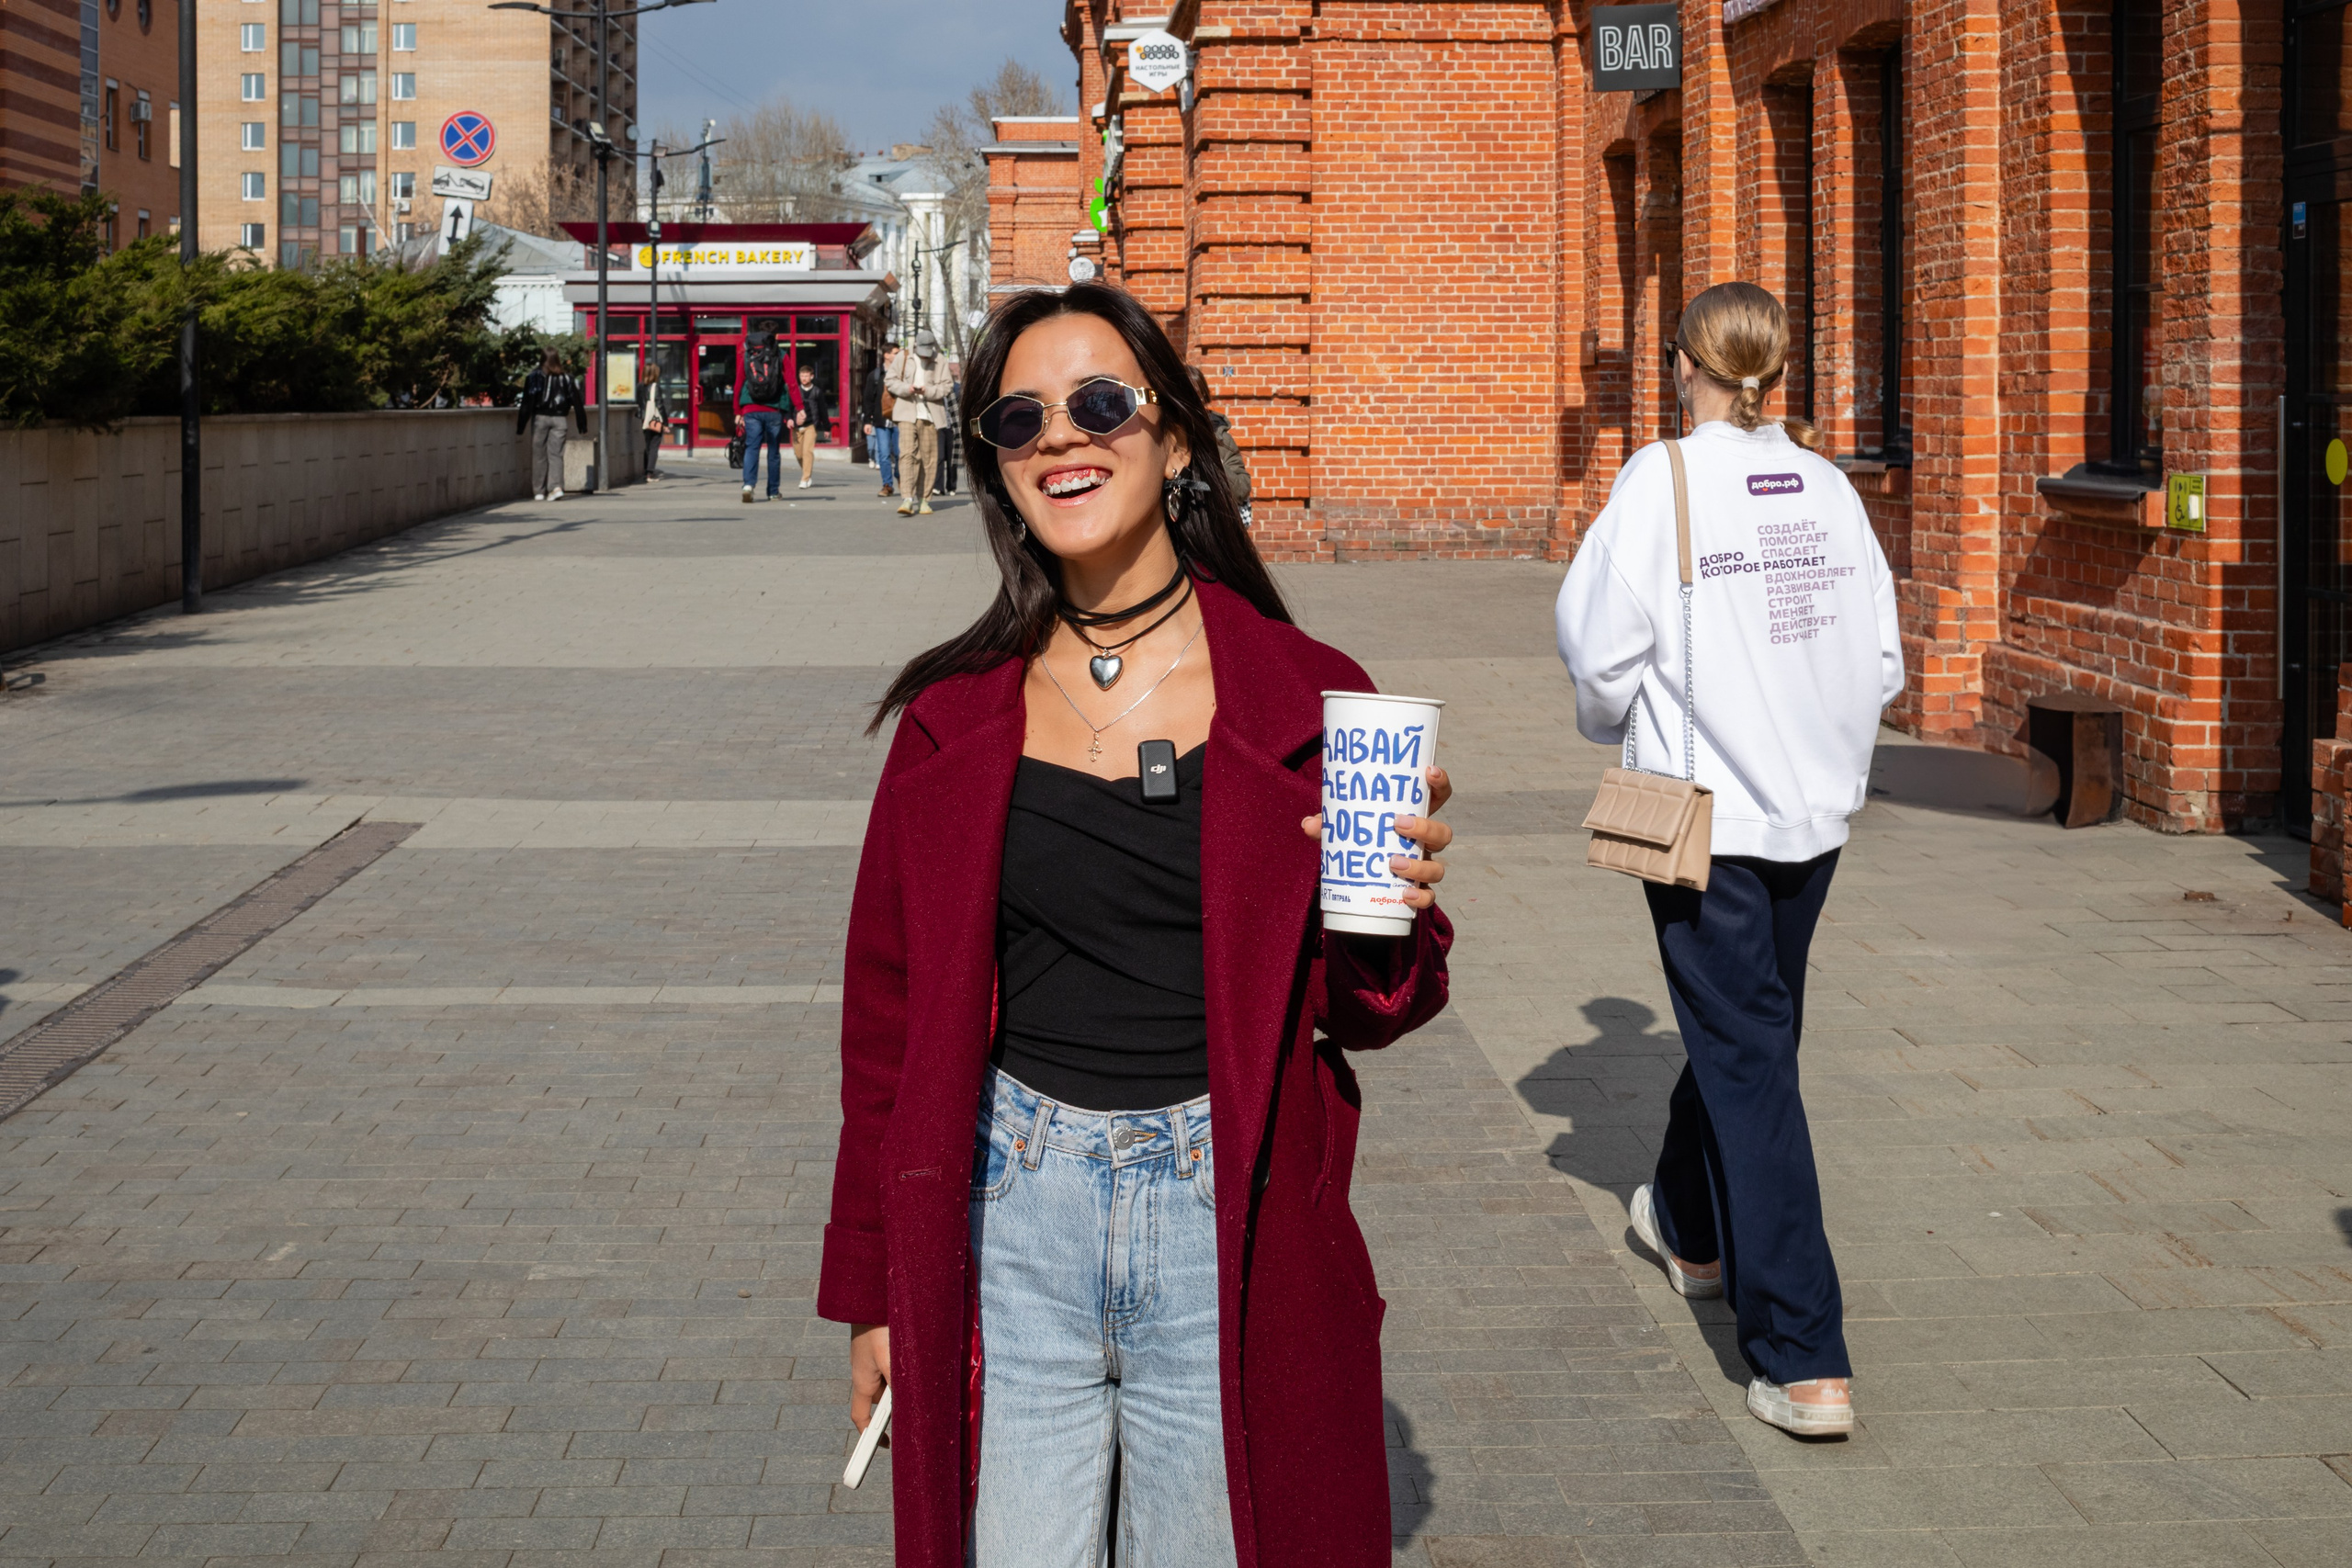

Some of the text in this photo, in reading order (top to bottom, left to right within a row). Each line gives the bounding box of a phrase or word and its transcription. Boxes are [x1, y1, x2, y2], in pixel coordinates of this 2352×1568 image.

[1600, 24, 1673, 71] BAR
[662, 250, 804, 265] FRENCH BAKERY
[1751, 477, 1800, 490] добро.рф
[1758, 519, 1817, 536] СОЗДАЁТ
[1758, 532, 1828, 547] ПОМОГАЕТ
[1699, 551, 1744, 569] ДОБРО
[1761, 545, 1818, 559] СПАСАЕТ
[1763, 556, 1826, 571] РАБОТАЕТ
[1765, 567, 1856, 584] ВДОХНОВЛЯЕТ
[1767, 580, 1836, 596] РАЗВИВАЕТ
[1768, 593, 1813, 608] СТРОИТ
[1769, 604, 1815, 620] МЕНЯЕТ
[1770, 615, 1838, 635] ДЕЙСТВУЕТ
[1770, 628, 1819, 645] ОБУЧАЕТ
[1323, 725, 1424, 768] ДАВАЙ
[1322, 767, 1423, 805] ДЕЛАТЬ
